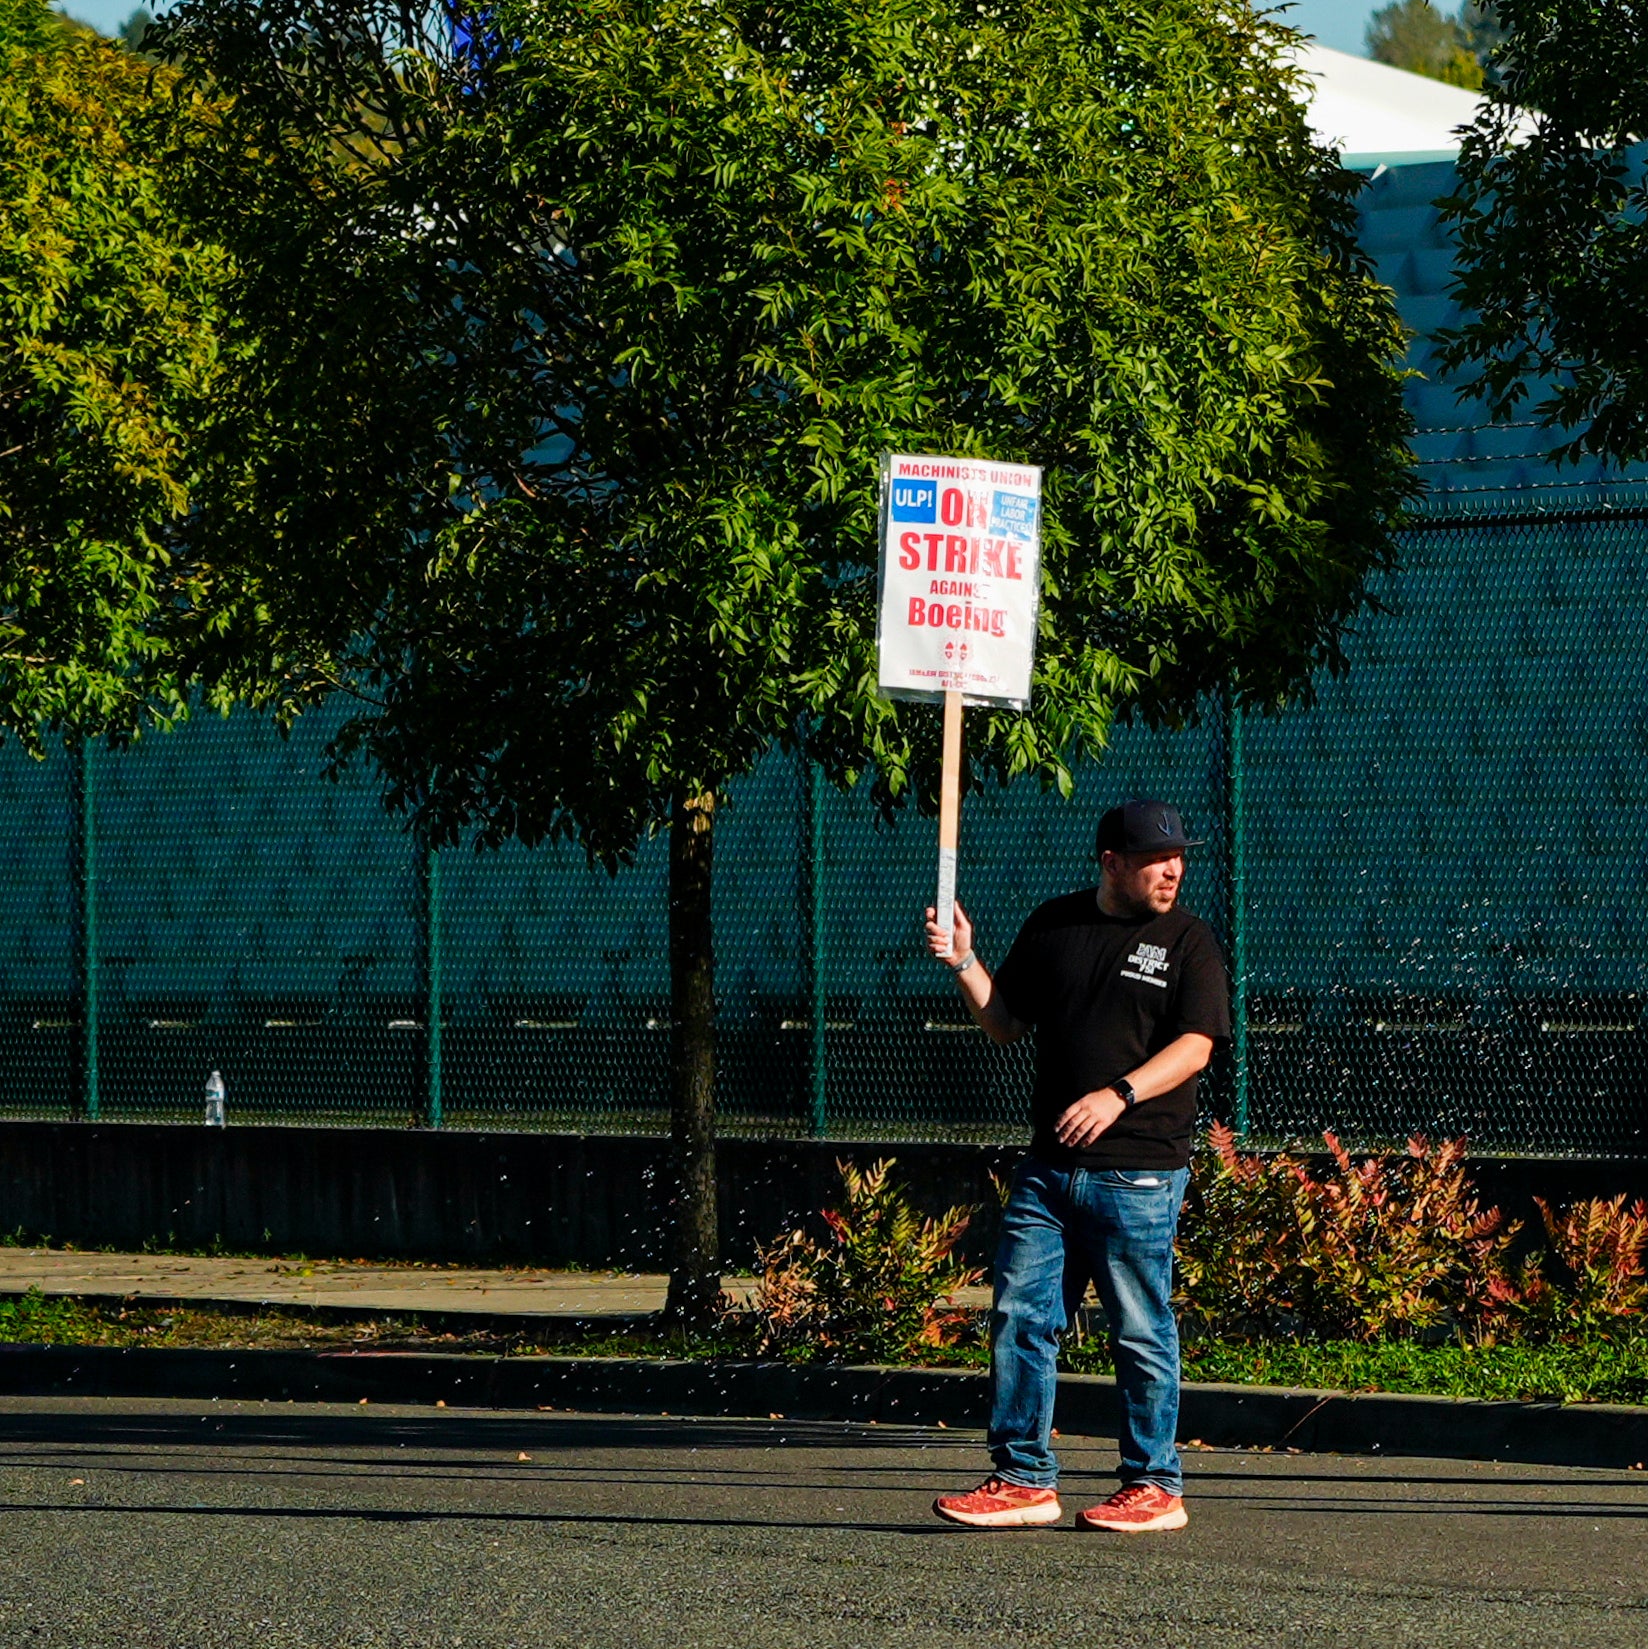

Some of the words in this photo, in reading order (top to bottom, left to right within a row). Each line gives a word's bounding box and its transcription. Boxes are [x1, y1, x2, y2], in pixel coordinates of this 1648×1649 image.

[898, 463, 986, 481] MACHINISTS
[990, 470, 1032, 487] UNION
[895, 488, 933, 507] ULP!
[941, 488, 988, 529] ON
[899, 531, 1023, 580] STRIKE
[930, 580, 991, 599] AGAIN
[908, 597, 1007, 637] Boeing
